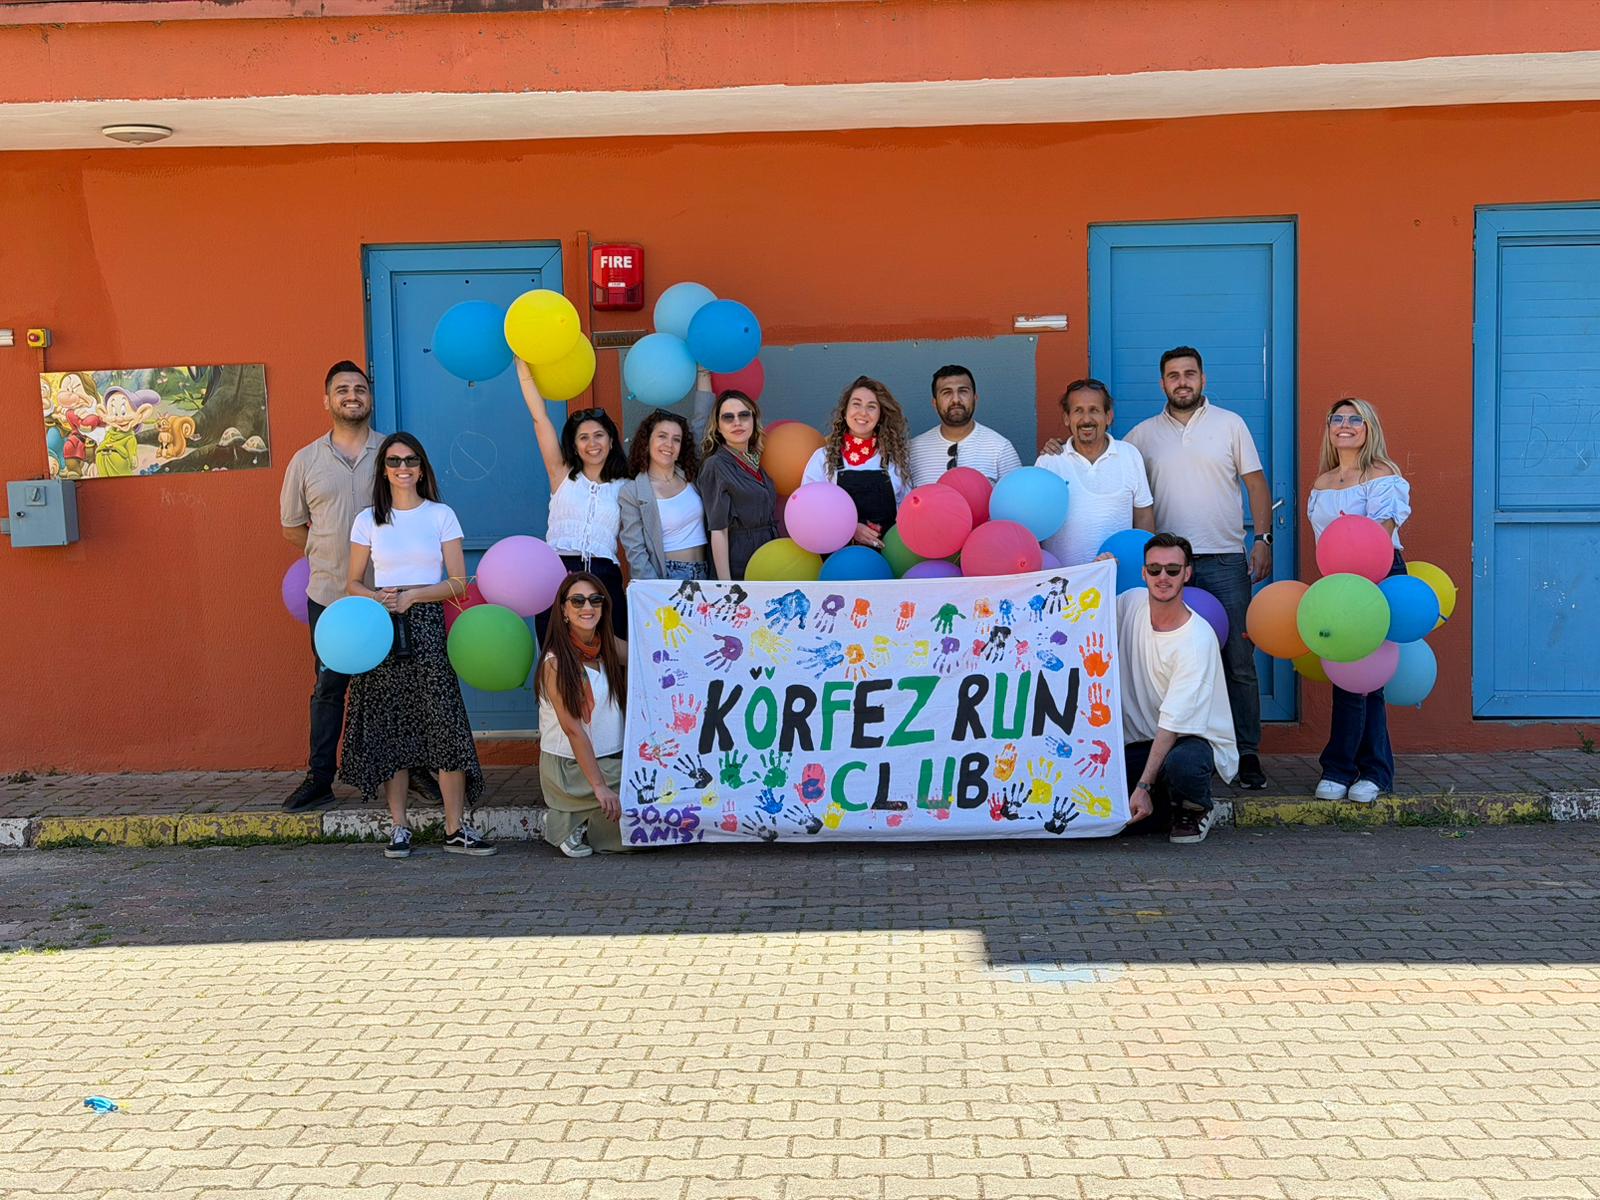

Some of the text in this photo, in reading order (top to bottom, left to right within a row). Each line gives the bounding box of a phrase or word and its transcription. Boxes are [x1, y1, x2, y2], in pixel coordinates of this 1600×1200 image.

[601, 256, 632, 268] FIRE
[699, 666, 1080, 755] KÖRFEZ RUN
[831, 752, 990, 812] CLUB
[625, 805, 701, 832] 30.05
